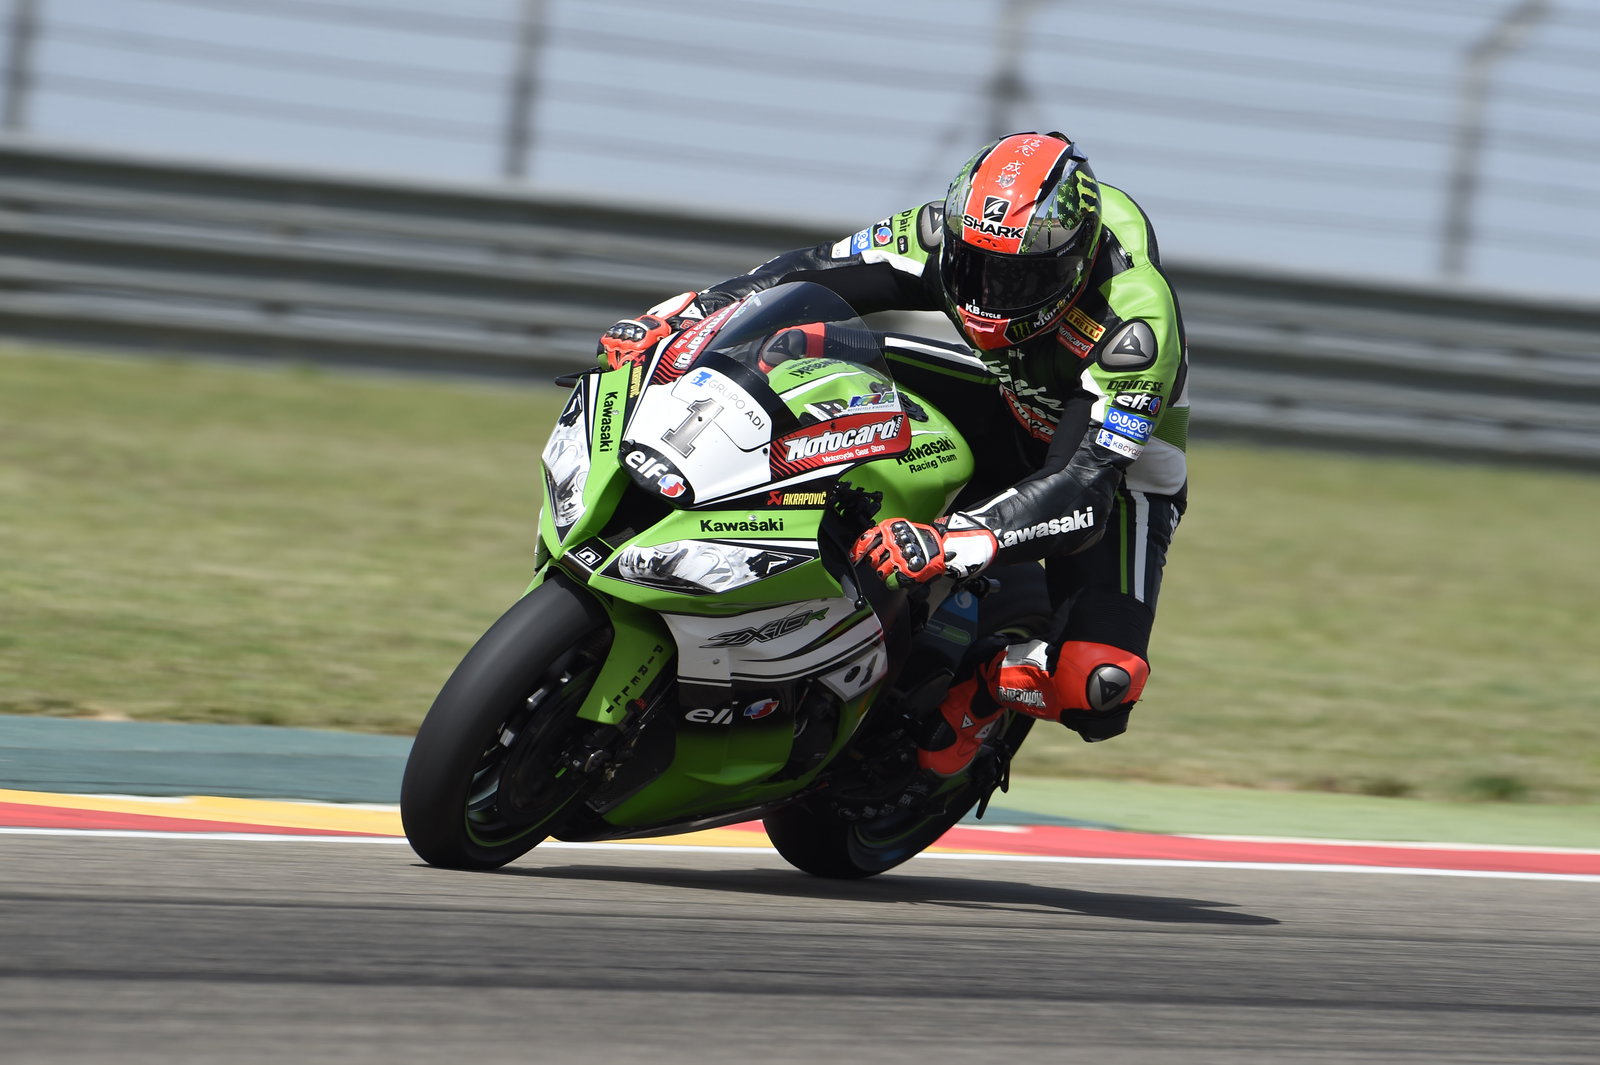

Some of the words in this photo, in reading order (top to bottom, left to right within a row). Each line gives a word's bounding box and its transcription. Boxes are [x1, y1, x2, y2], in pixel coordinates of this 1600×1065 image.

[963, 214, 1025, 240] SHARK
[980, 311, 1001, 320] CYCLE
[1106, 380, 1164, 393] DAINESE
[708, 379, 746, 410] GRUPO
[744, 410, 766, 430] ADI
[1114, 392, 1150, 411] elf
[600, 391, 619, 452] Kawasaki
[661, 398, 725, 459] 1
[784, 419, 897, 462] Motocard
[625, 450, 669, 480] elf
[822, 451, 854, 464] Motorcycle
[855, 447, 870, 457] Gear
[870, 443, 886, 453] Store
[908, 460, 939, 474] Racing
[939, 453, 958, 465] Team
[700, 518, 784, 533] Kawasaki
